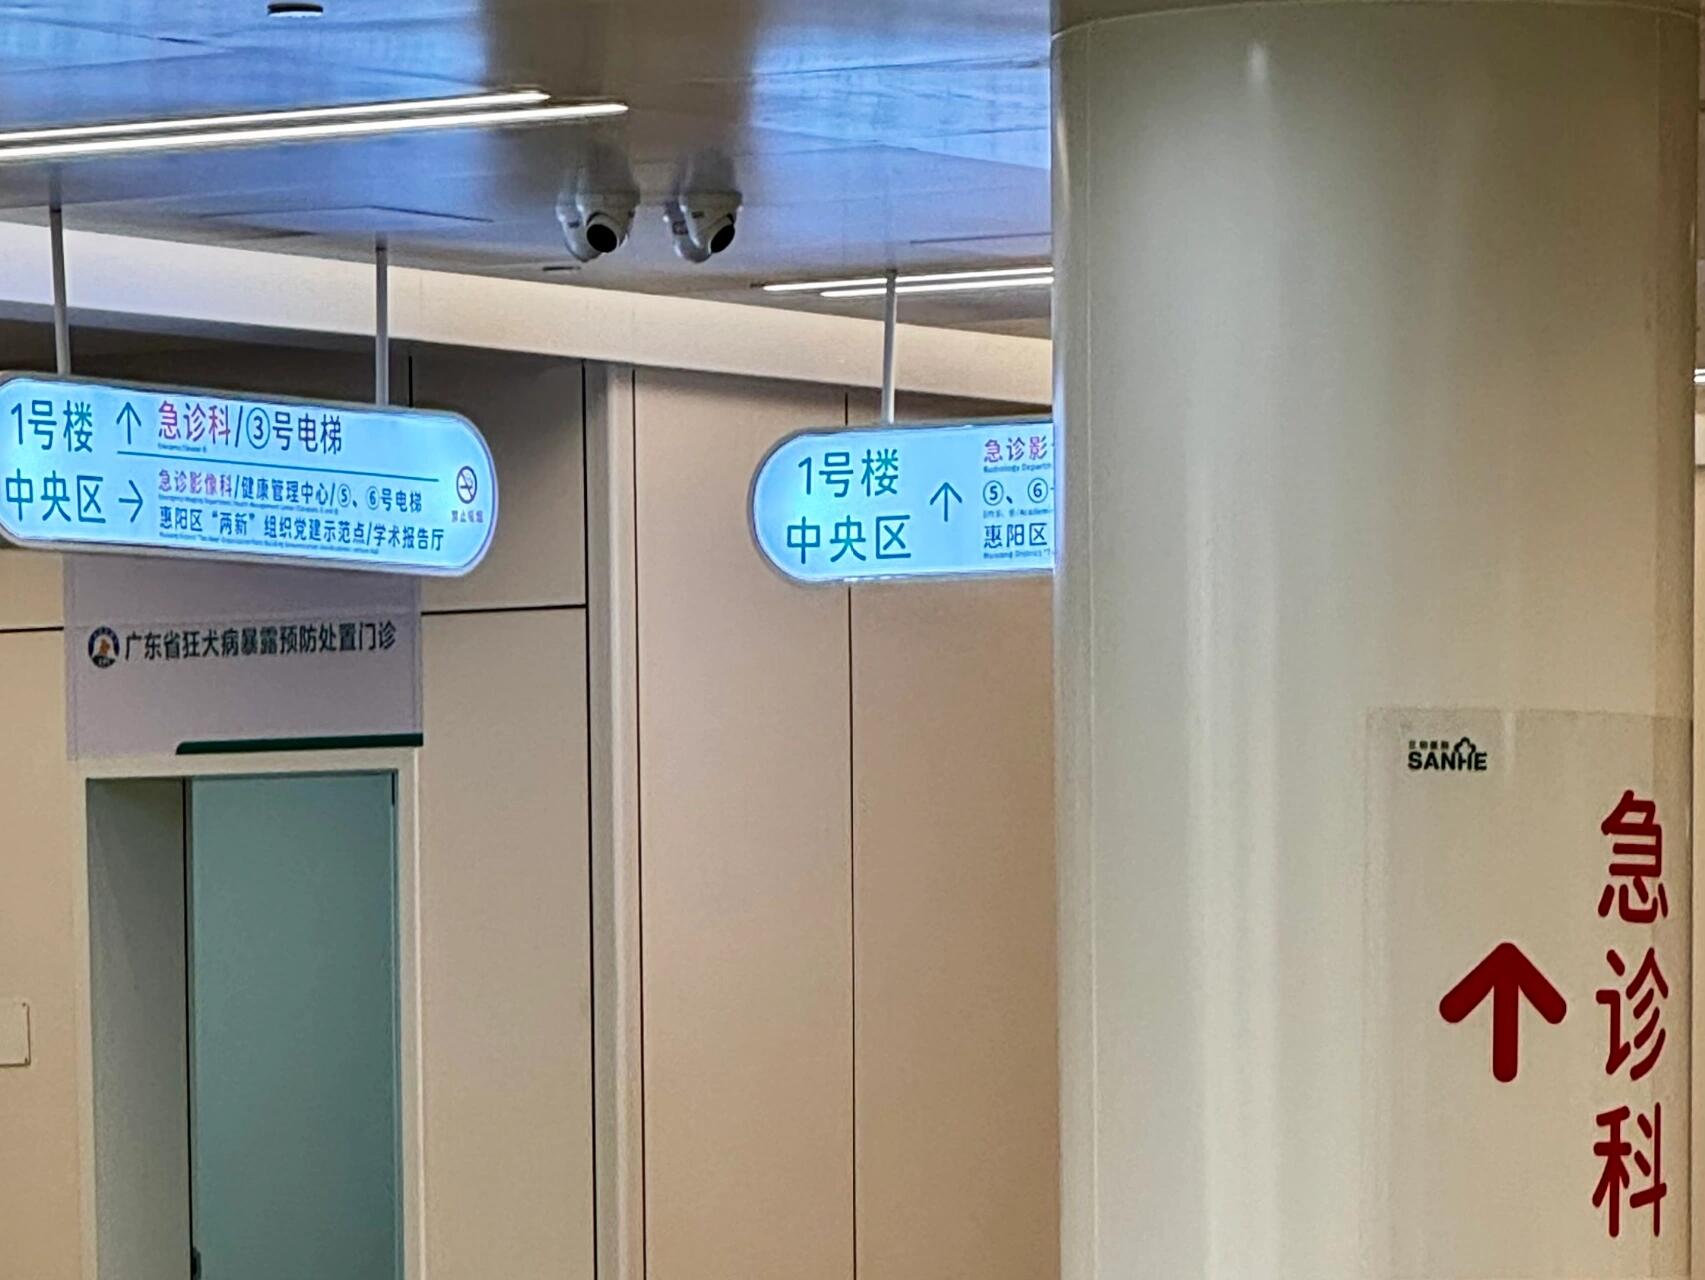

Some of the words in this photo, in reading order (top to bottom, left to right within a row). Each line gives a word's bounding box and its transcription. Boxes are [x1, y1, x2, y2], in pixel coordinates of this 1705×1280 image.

[11, 399, 94, 453] 1号楼
[157, 399, 343, 455] 急诊科/③号电梯
[984, 435, 1054, 463] 急诊影
[5, 467, 107, 524] 中央区
[798, 448, 899, 498] 1号楼
[983, 477, 1054, 506] ⑤、⑥
[787, 514, 912, 565] 中央区
[984, 522, 1048, 549] 惠阳区
[124, 620, 397, 661] 广东省狂犬病暴露预防处置门诊
[1407, 748, 1488, 771] SANHE
[1592, 789, 1669, 1238] 急诊科
